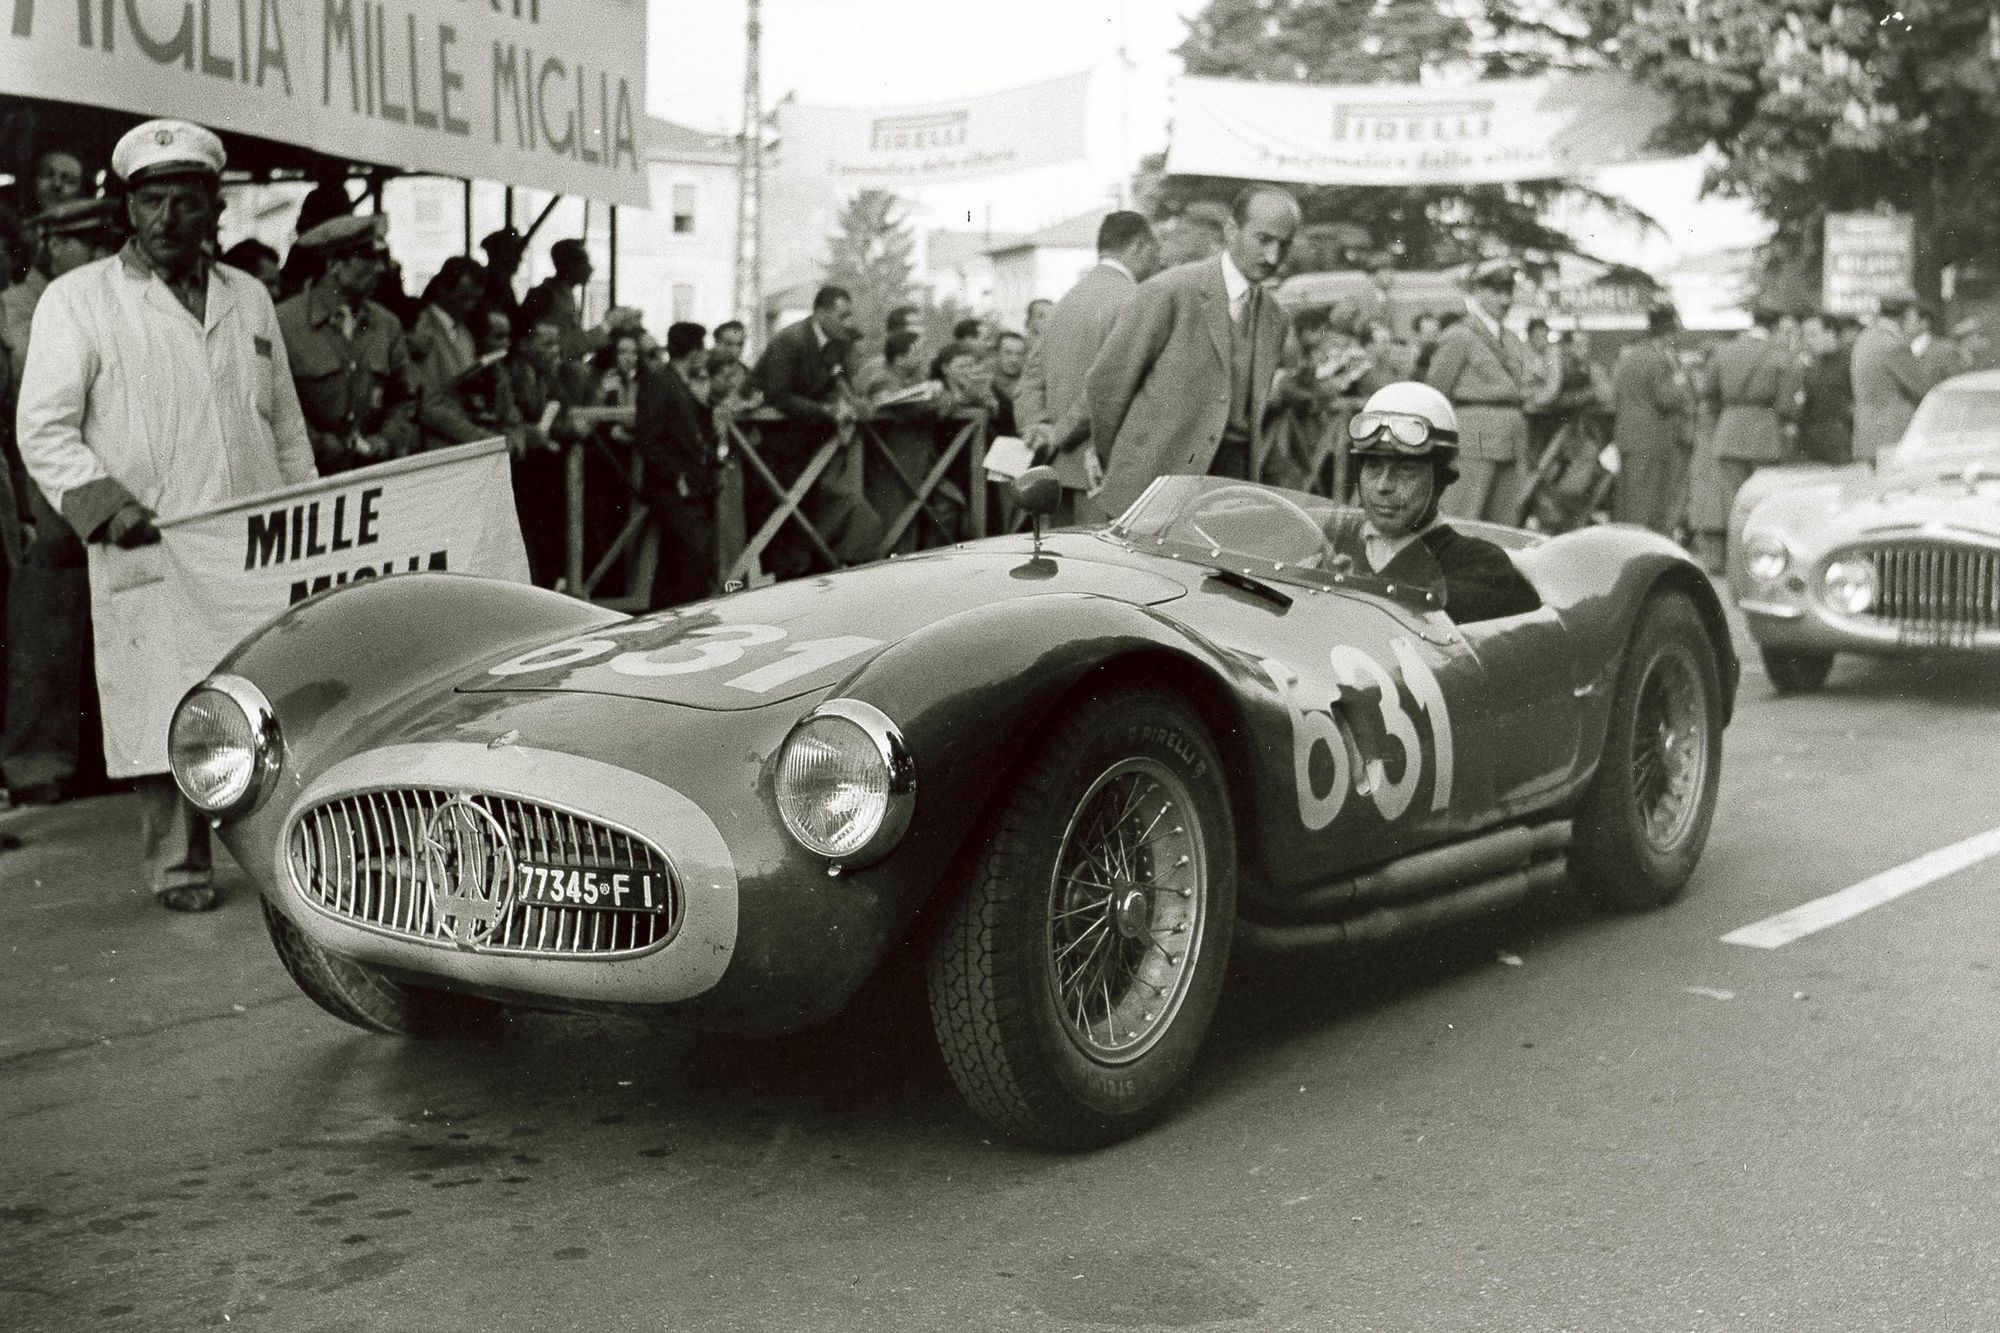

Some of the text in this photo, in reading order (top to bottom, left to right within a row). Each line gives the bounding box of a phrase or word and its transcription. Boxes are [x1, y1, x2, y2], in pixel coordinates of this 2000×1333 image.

[322, 0, 470, 136] MILLE
[492, 38, 638, 174] MIGLIA
[869, 109, 969, 151] PIRELLI
[1331, 99, 1496, 142] PIRELLI
[244, 486, 383, 572] MILLE
[487, 620, 884, 694] 631
[1141, 725, 1196, 765] PIRELLI
[1259, 636, 1454, 830] 631
[521, 865, 599, 905] 77345
